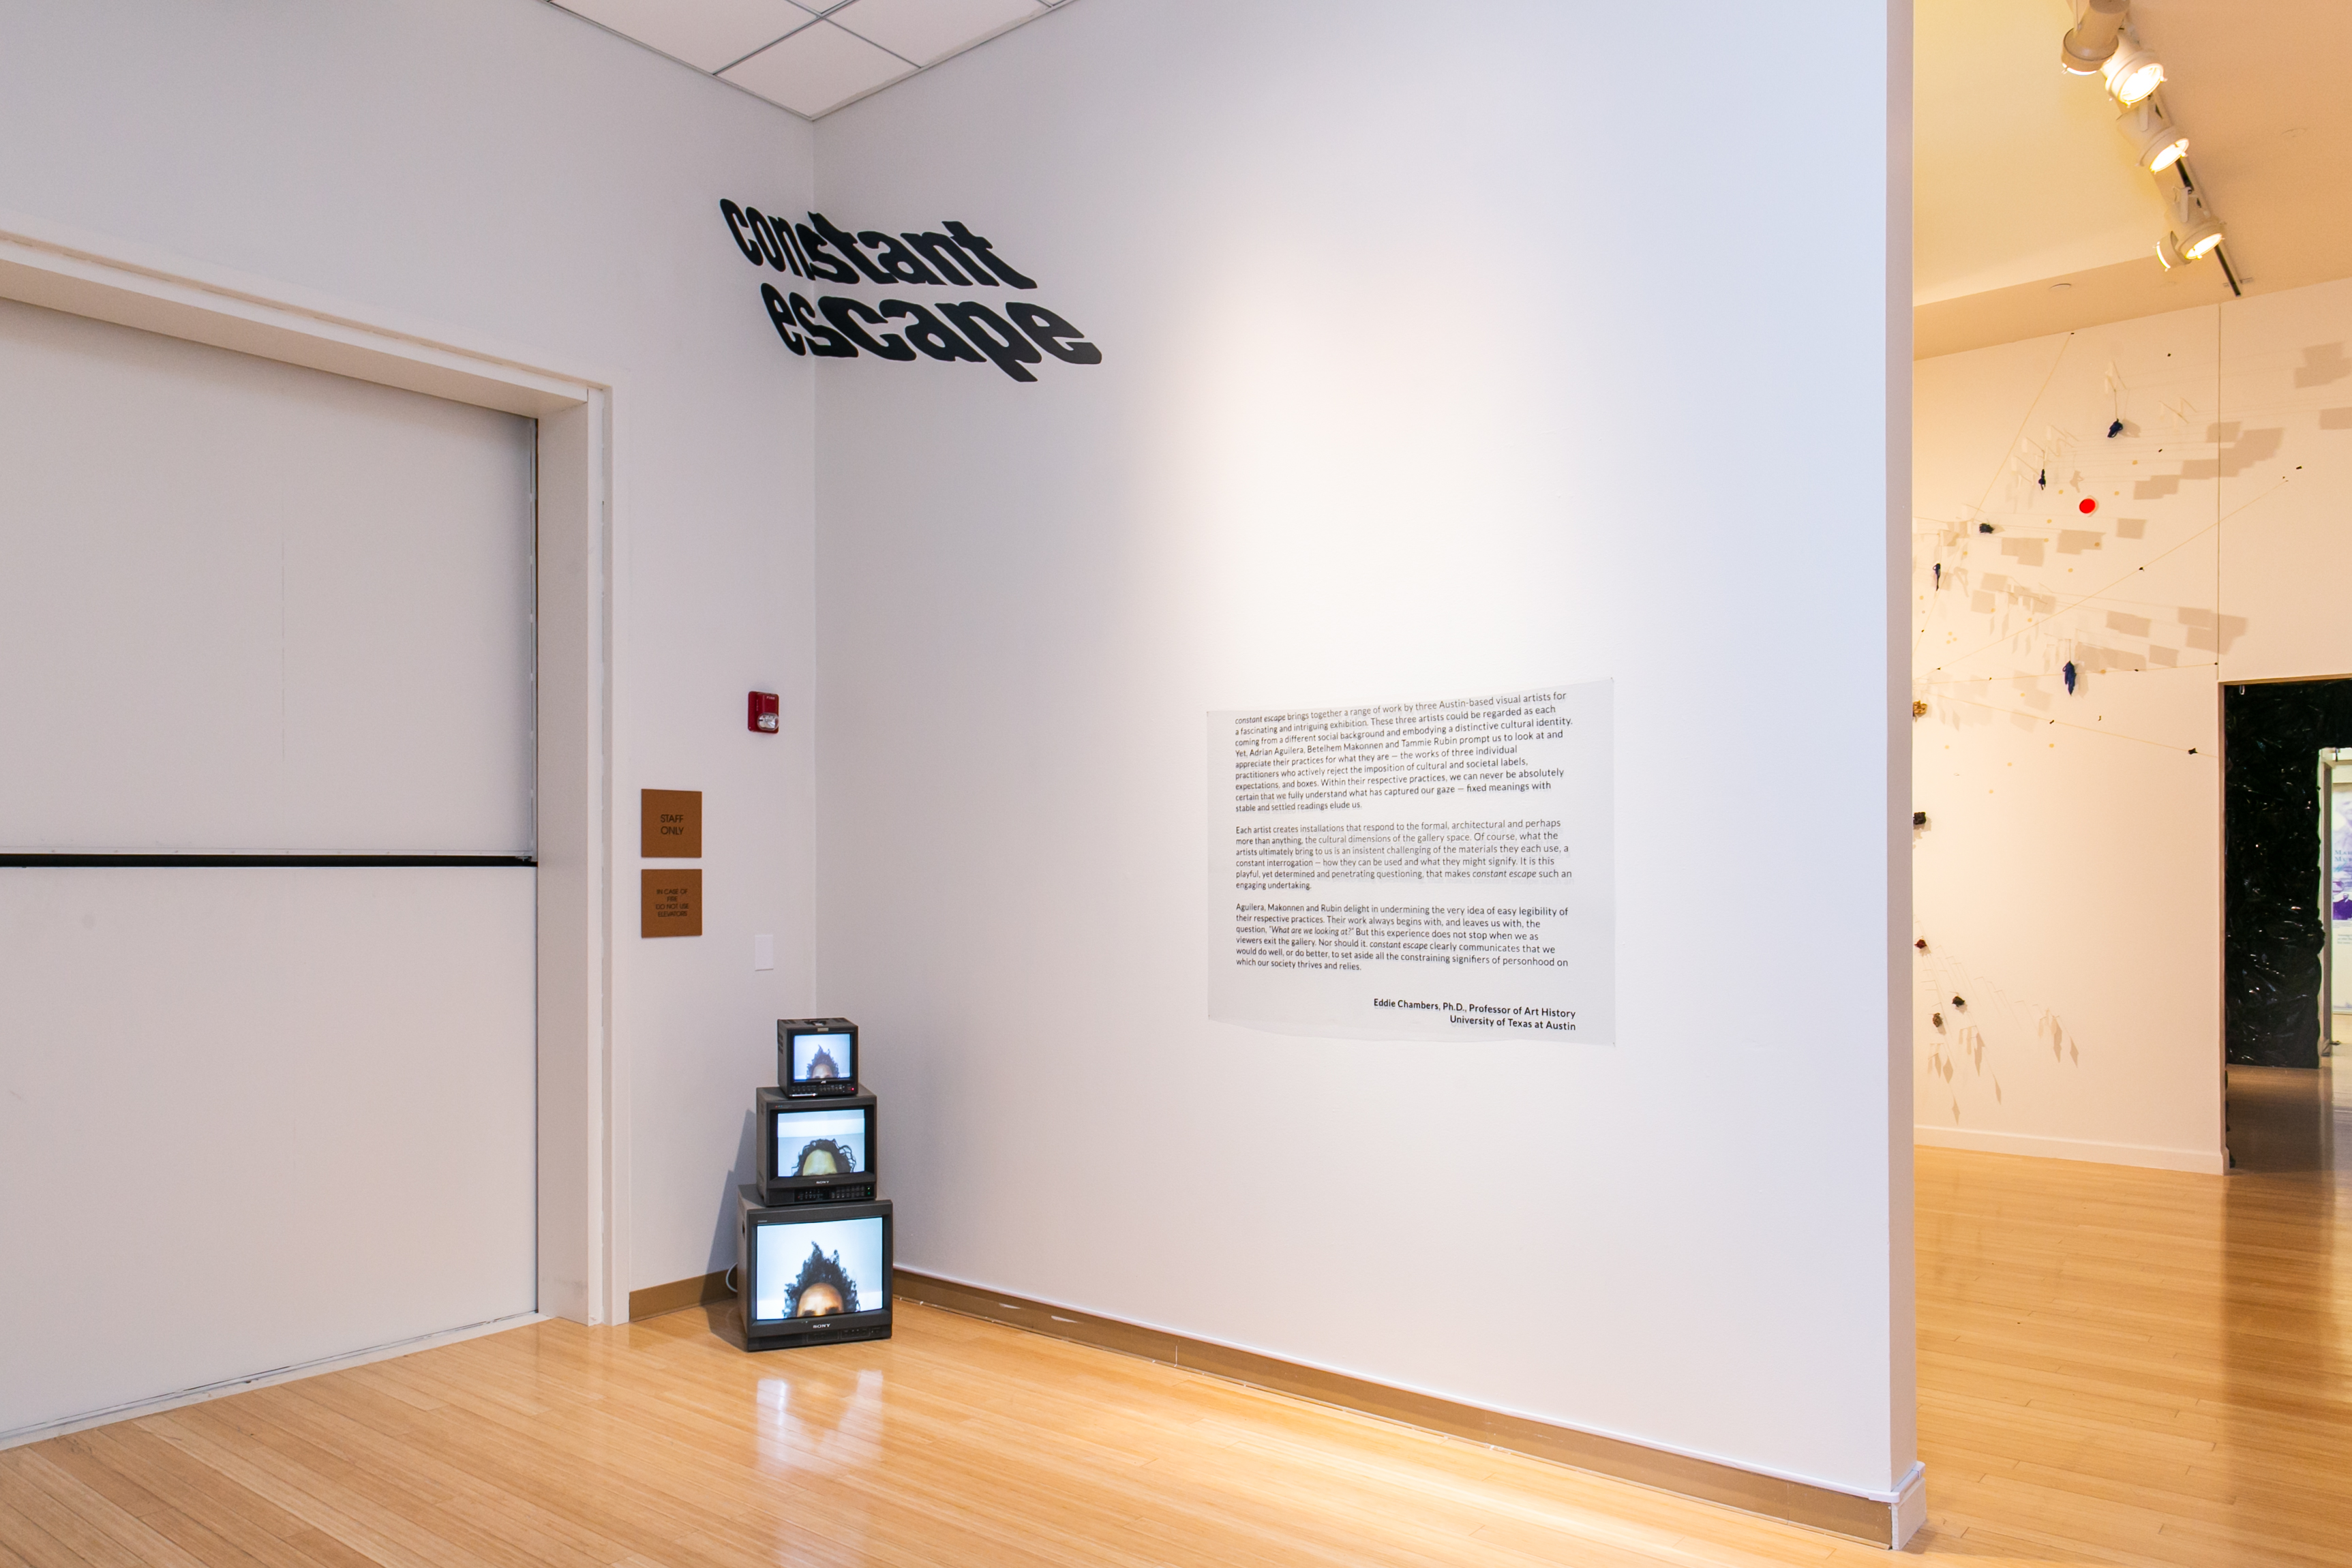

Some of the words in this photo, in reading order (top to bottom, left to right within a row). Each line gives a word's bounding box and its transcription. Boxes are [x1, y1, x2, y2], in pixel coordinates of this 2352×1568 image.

[720, 198, 1038, 289] constant
[761, 282, 1102, 382] escape
[1235, 716, 1263, 725] constant
[1286, 712, 1310, 721] brings
[1310, 709, 1343, 720] together
[1350, 708, 1372, 717] range
[1372, 705, 1381, 714] of
[1382, 704, 1402, 713] work
[1404, 704, 1414, 712] by
[1415, 702, 1438, 711] three
[1438, 697, 1494, 708] Austin-based
[1495, 694, 1521, 704] visual
[1523, 693, 1552, 703] artists
[1553, 691, 1567, 700] for
[1235, 738, 1260, 747] coming
[1284, 735, 1316, 743] different
[1318, 732, 1339, 741] social
[1340, 729, 1385, 740] background
[1386, 728, 1401, 736] and
[1402, 726, 1447, 736] embodying
[1455, 722, 1499, 732] distinctive
[1501, 719, 1534, 729] cultural
[1536, 717, 1573, 727] identity.
[1235, 760, 1271, 769] appreciate
[1273, 758, 1290, 766] their
[1291, 757, 1324, 766] practices
[1325, 755, 1336, 764] for
[1358, 754, 1375, 762] they
[1400, 751, 1413, 759] the
[1415, 750, 1440, 758] works
[1441, 749, 1449, 757] of
[1451, 749, 1474, 757] three
[1475, 745, 1518, 755] individual
[1235, 771, 1280, 781] practitioners
[1280, 769, 1296, 777] who
[1297, 768, 1325, 777] actively
[1327, 767, 1348, 776] reject
[1350, 766, 1363, 774] the
[1364, 764, 1405, 774] imposition
[1406, 762, 1415, 771] of
[1416, 761, 1447, 770] cultural
[1449, 760, 1464, 769] and
[1466, 759, 1498, 768] societal
[1501, 757, 1528, 766] labels,
[1288, 791, 1304, 800] fully
[1305, 789, 1347, 798] understand
[1348, 789, 1368, 797] what
[1369, 788, 1383, 796] has
[1384, 787, 1419, 796] captured
[1436, 787, 1456, 796] gaze
[1466, 783, 1487, 792] fixed
[1488, 783, 1530, 792] meanings
[1531, 781, 1552, 789] with
[661, 814, 684, 823] STAFF
[1235, 826, 1252, 834] Each
[1253, 826, 1271, 834] artist
[1299, 824, 1344, 832] installations
[1346, 824, 1362, 832] that
[1363, 823, 1395, 832] respond
[1406, 822, 1419, 830] the
[1421, 821, 1449, 830] formal,
[1451, 819, 1506, 829] architectural
[1507, 819, 1524, 828] and
[1525, 819, 1561, 829] perhaps
[661, 826, 684, 835] ONLY
[1258, 847, 1294, 856] ultimately
[1295, 847, 1314, 857] bring
[1333, 847, 1340, 855] is
[1352, 846, 1385, 854] insistent
[1386, 845, 1432, 856] challenging
[1432, 845, 1441, 854] of
[1443, 845, 1457, 854] the
[1458, 845, 1498, 854] materials
[1499, 845, 1519, 854] they
[1520, 844, 1541, 853] each
[1235, 870, 1261, 879] playful,
[1273, 870, 1316, 878] determined
[1316, 870, 1331, 878] and
[1331, 870, 1376, 879] penetrating
[1376, 869, 1425, 879] questioning,
[1426, 869, 1443, 877] that
[1444, 869, 1471, 878] makes
[1472, 870, 1507, 878] constant
[1508, 871, 1537, 879] escape
[1538, 869, 1559, 878] such
[1267, 881, 1312, 891] undertaking.
[1235, 903, 1267, 912] Aguilera,
[1267, 903, 1305, 911] Makonnen
[1306, 904, 1319, 912] and
[1321, 904, 1342, 912] Rubin
[1343, 904, 1370, 914] delight
[1371, 905, 1379, 913] in
[1380, 905, 1430, 916] undermining
[1431, 905, 1445, 914] the
[1446, 907, 1466, 916] very
[1466, 906, 1485, 915] idea
[1486, 906, 1496, 915] of
[1496, 908, 1518, 916] easy
[1518, 907, 1557, 917] legibility
[1558, 907, 1569, 916] of
[1373, 998, 1396, 1008] Eddie
[1397, 999, 1441, 1010] Chambers,
[1468, 1004, 1511, 1014] Professor
[1512, 1006, 1522, 1015] of
[1524, 1007, 1539, 1016] Art
[1541, 1008, 1576, 1019] History
[1449, 1015, 1494, 1027] University
[1496, 1018, 1506, 1026] of
[1508, 1018, 1533, 1028] Texas
[1545, 1021, 1576, 1031] Austin
